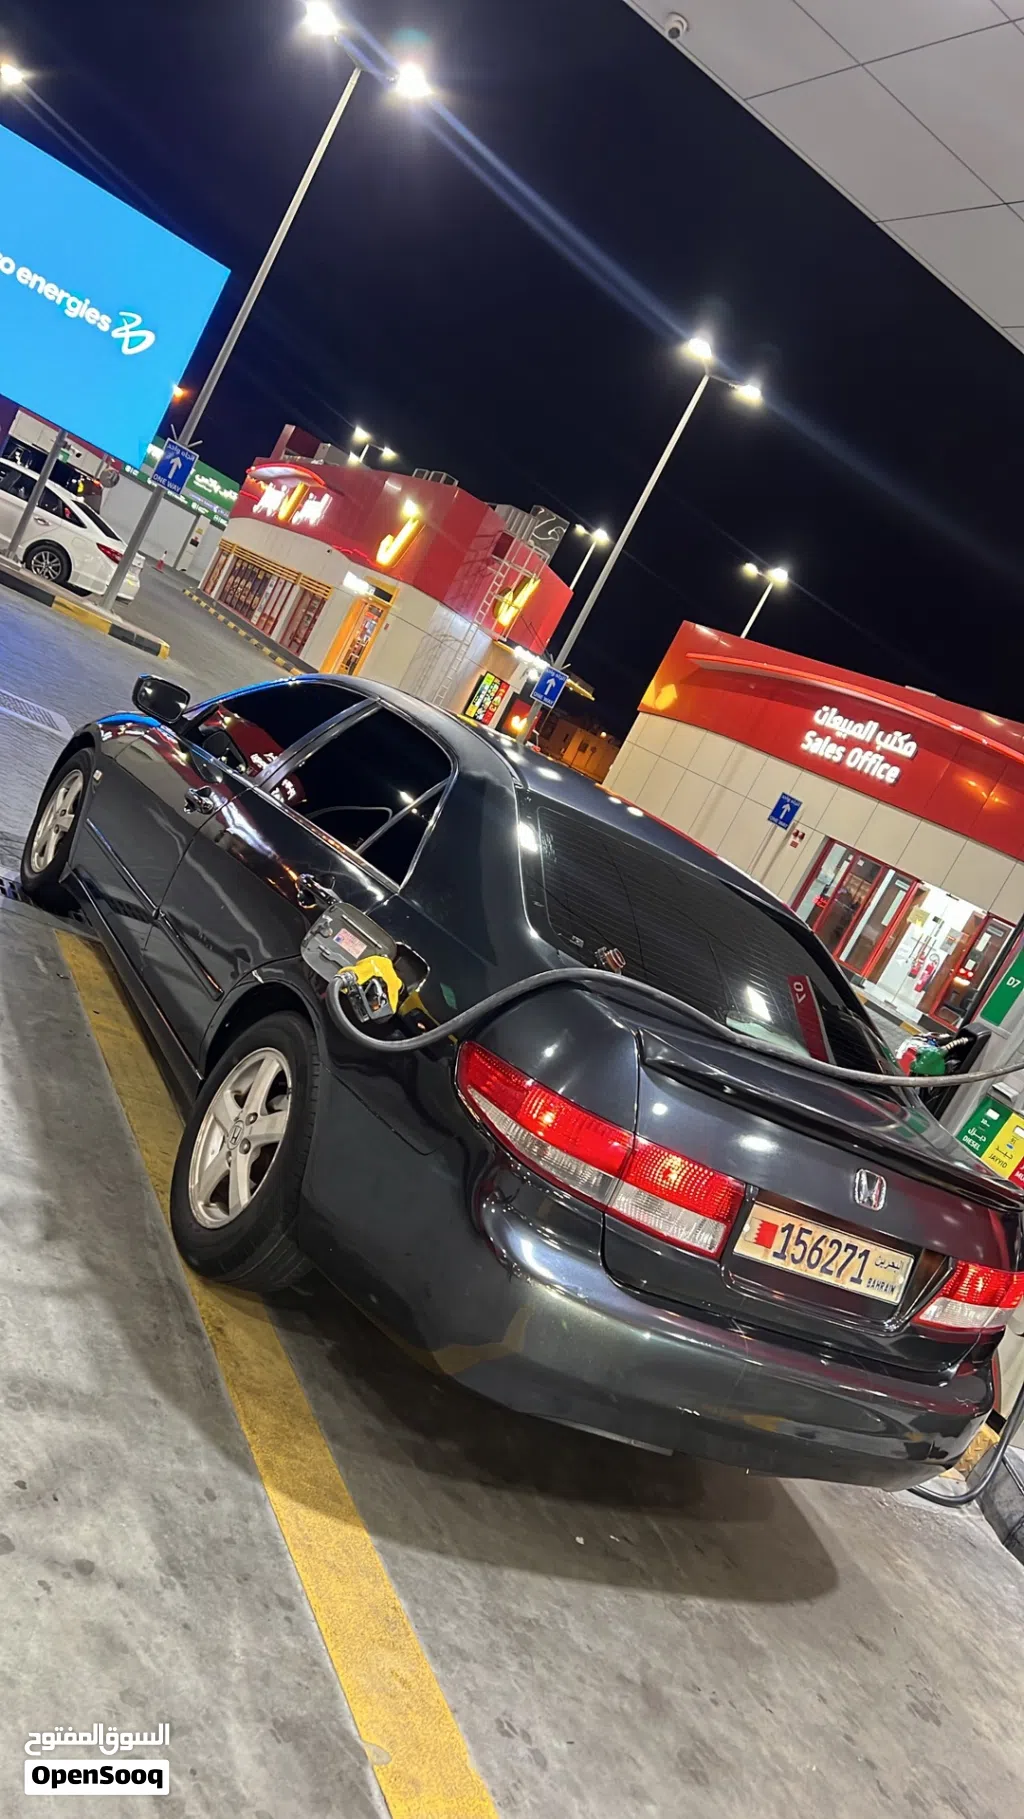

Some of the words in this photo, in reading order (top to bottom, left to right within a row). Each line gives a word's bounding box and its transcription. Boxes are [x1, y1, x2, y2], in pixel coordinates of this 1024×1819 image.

[16, 266, 112, 332] energies
[152, 473, 167, 485] ONE
[167, 480, 181, 492] WAY
[813, 705, 879, 742] المبيعات
[875, 730, 918, 758] مكتب
[800, 730, 846, 762] Sales
[845, 747, 901, 783] Office
[1006, 976, 1021, 988] D7
[962, 1135, 981, 1151] DIESEL
[988, 1153, 1008, 1169] JAYYID
[773, 1222, 871, 1285] 156271
[866, 1277, 897, 1295] BAHRAIN
